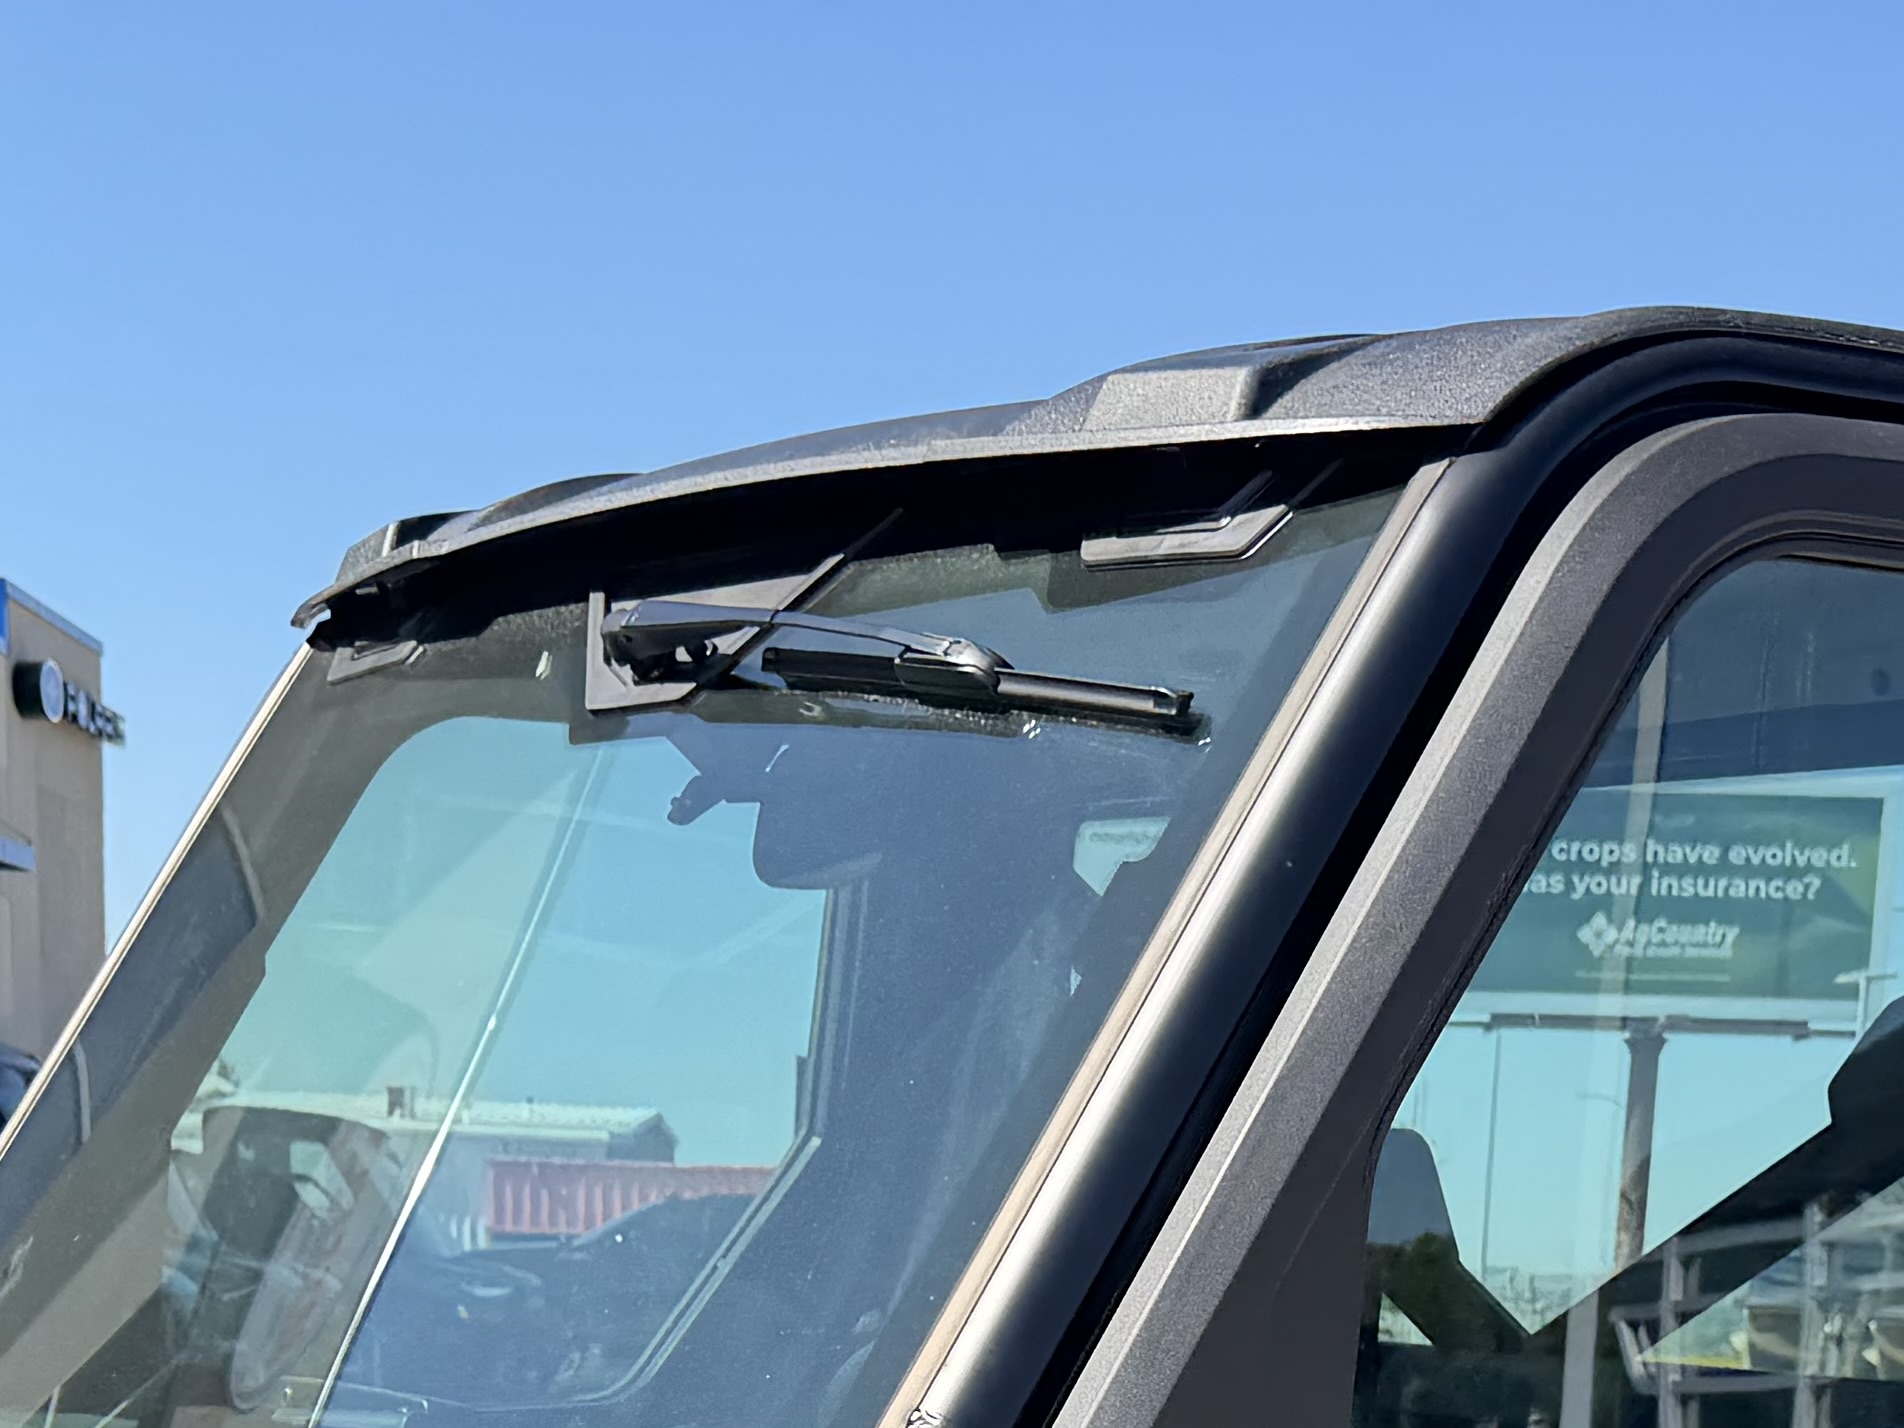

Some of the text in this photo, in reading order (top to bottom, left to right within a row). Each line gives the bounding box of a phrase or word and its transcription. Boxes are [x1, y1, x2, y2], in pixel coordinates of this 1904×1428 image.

[1551, 838, 1857, 868] crops have evolved.
[1522, 867, 1822, 900] as your insurance?
